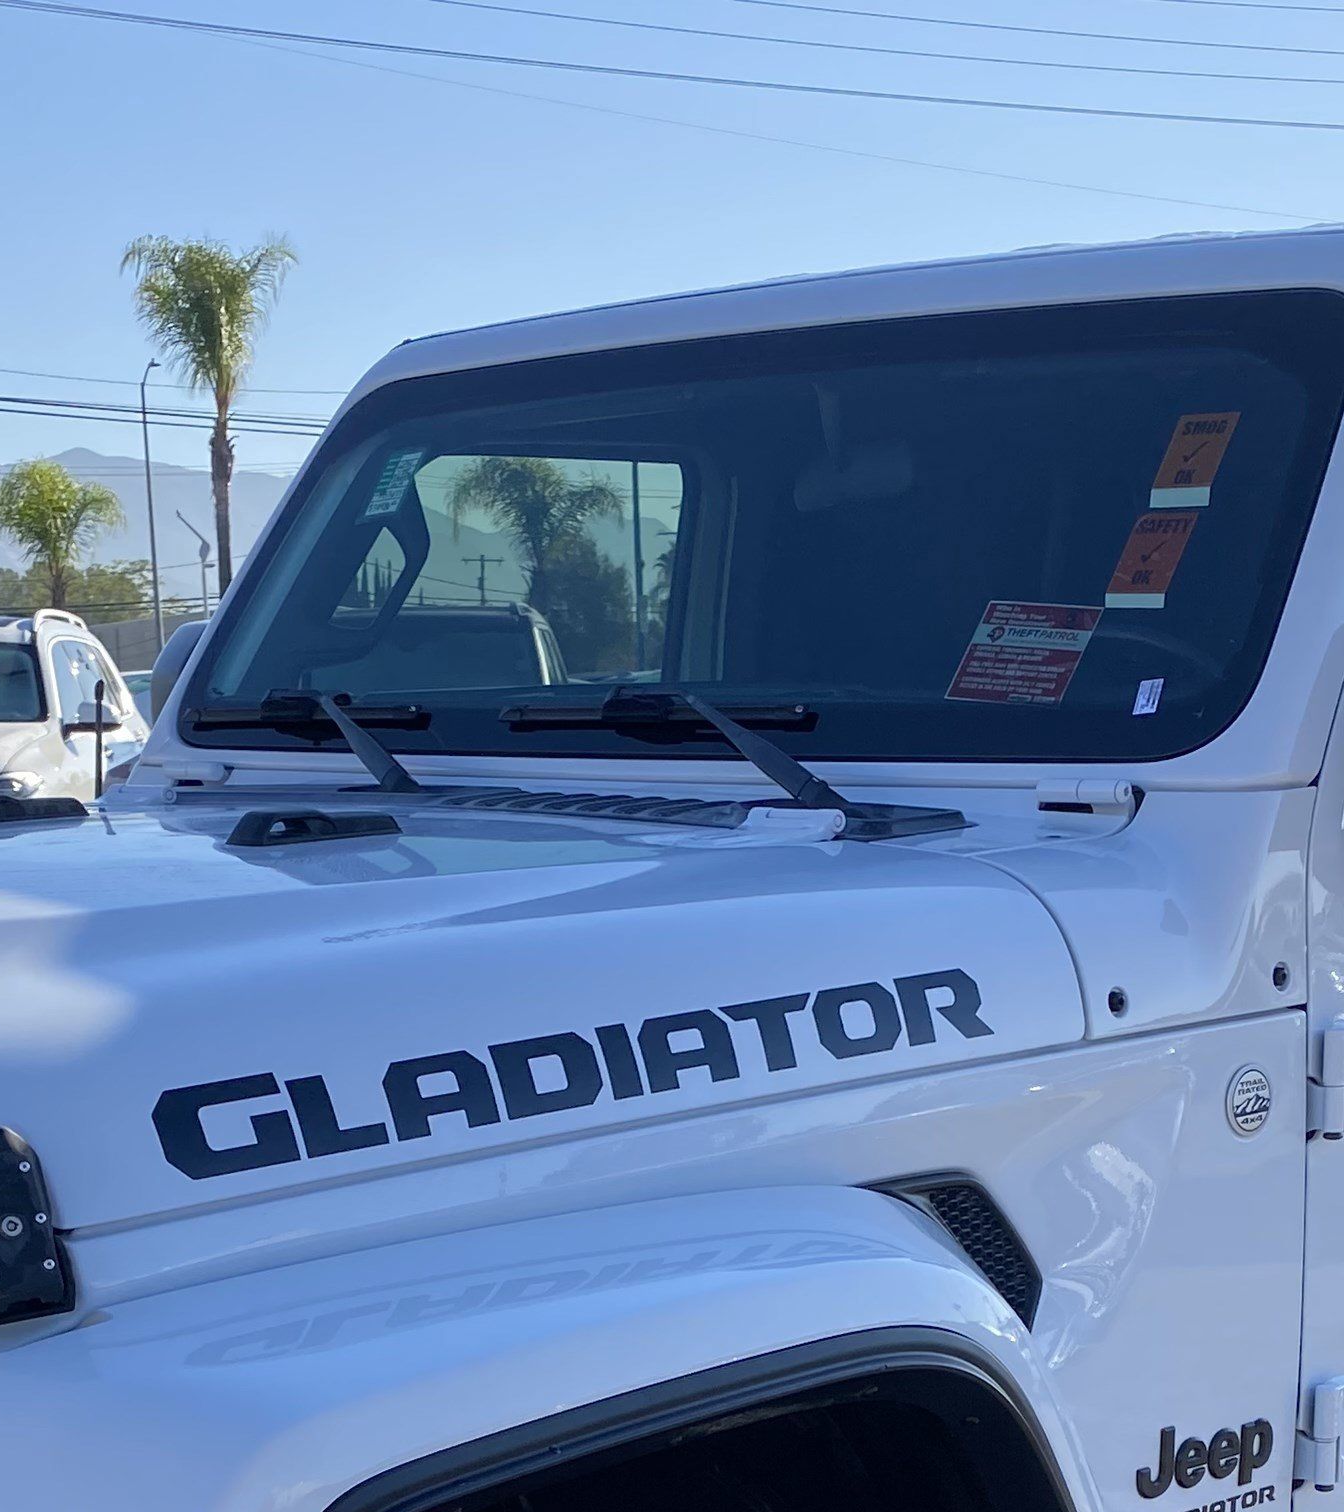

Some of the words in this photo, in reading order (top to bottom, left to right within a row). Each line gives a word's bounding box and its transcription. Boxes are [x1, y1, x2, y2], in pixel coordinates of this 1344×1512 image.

[1181, 420, 1229, 437] SMOG
[1174, 469, 1196, 485] OK
[1136, 518, 1192, 535] SAFETY
[1131, 569, 1154, 585] OK
[152, 968, 995, 1180] GLADIATOR
[1238, 1084, 1267, 1096] RATED
[1240, 1078, 1265, 1088] TRAIL
[1136, 1417, 1273, 1499] Jeep
